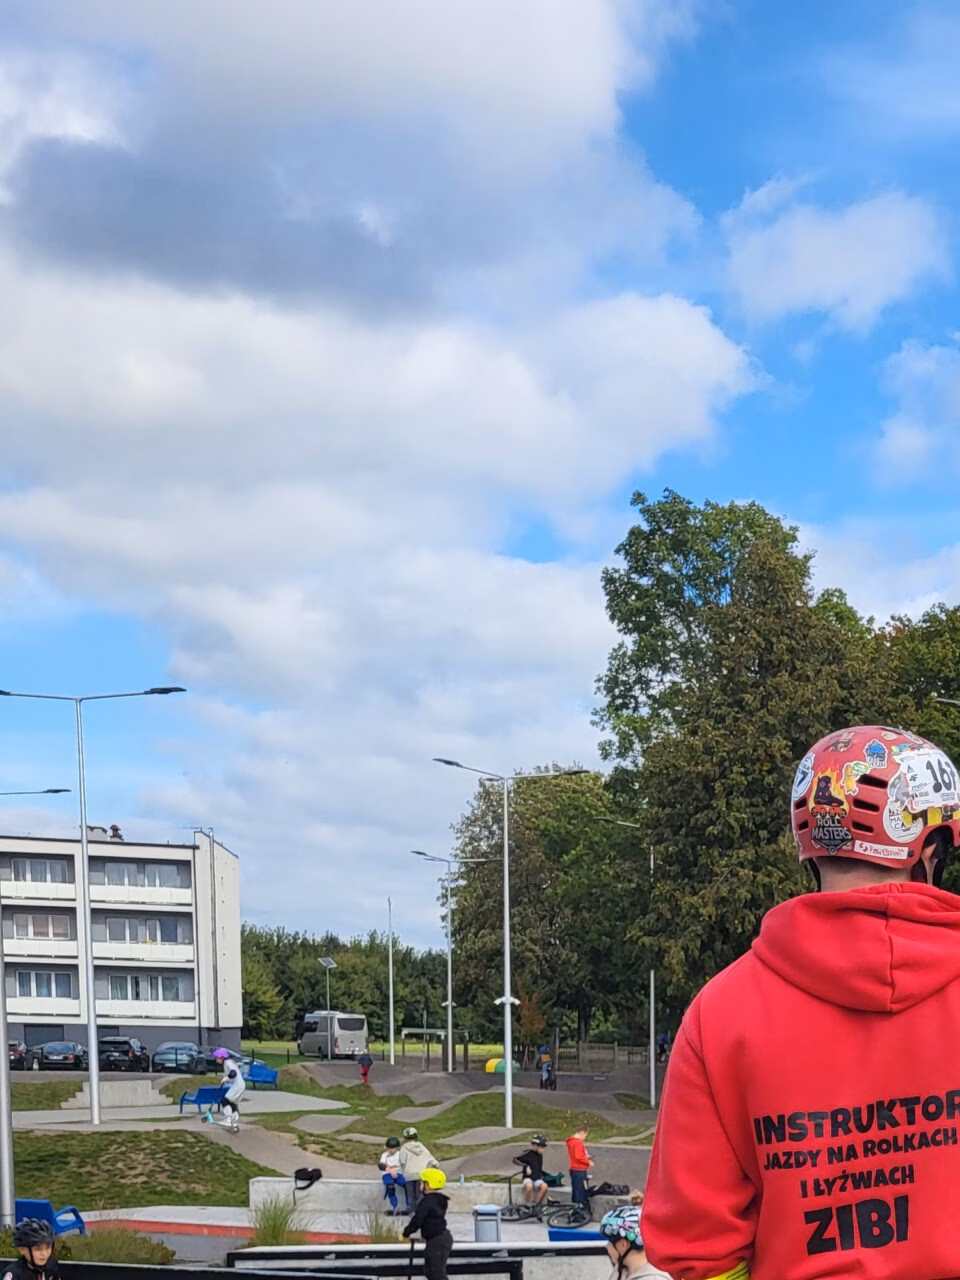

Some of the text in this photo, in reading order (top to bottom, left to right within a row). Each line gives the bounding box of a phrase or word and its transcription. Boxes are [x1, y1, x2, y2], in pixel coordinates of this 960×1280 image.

[811, 827, 852, 840] MASTERS
[818, 818, 842, 827] ROLL
[763, 1127, 958, 1170] JAZDY NA ROLKACH
[800, 1164, 915, 1198] I ŁYŻWACH
[804, 1195, 909, 1256] ZIBI
